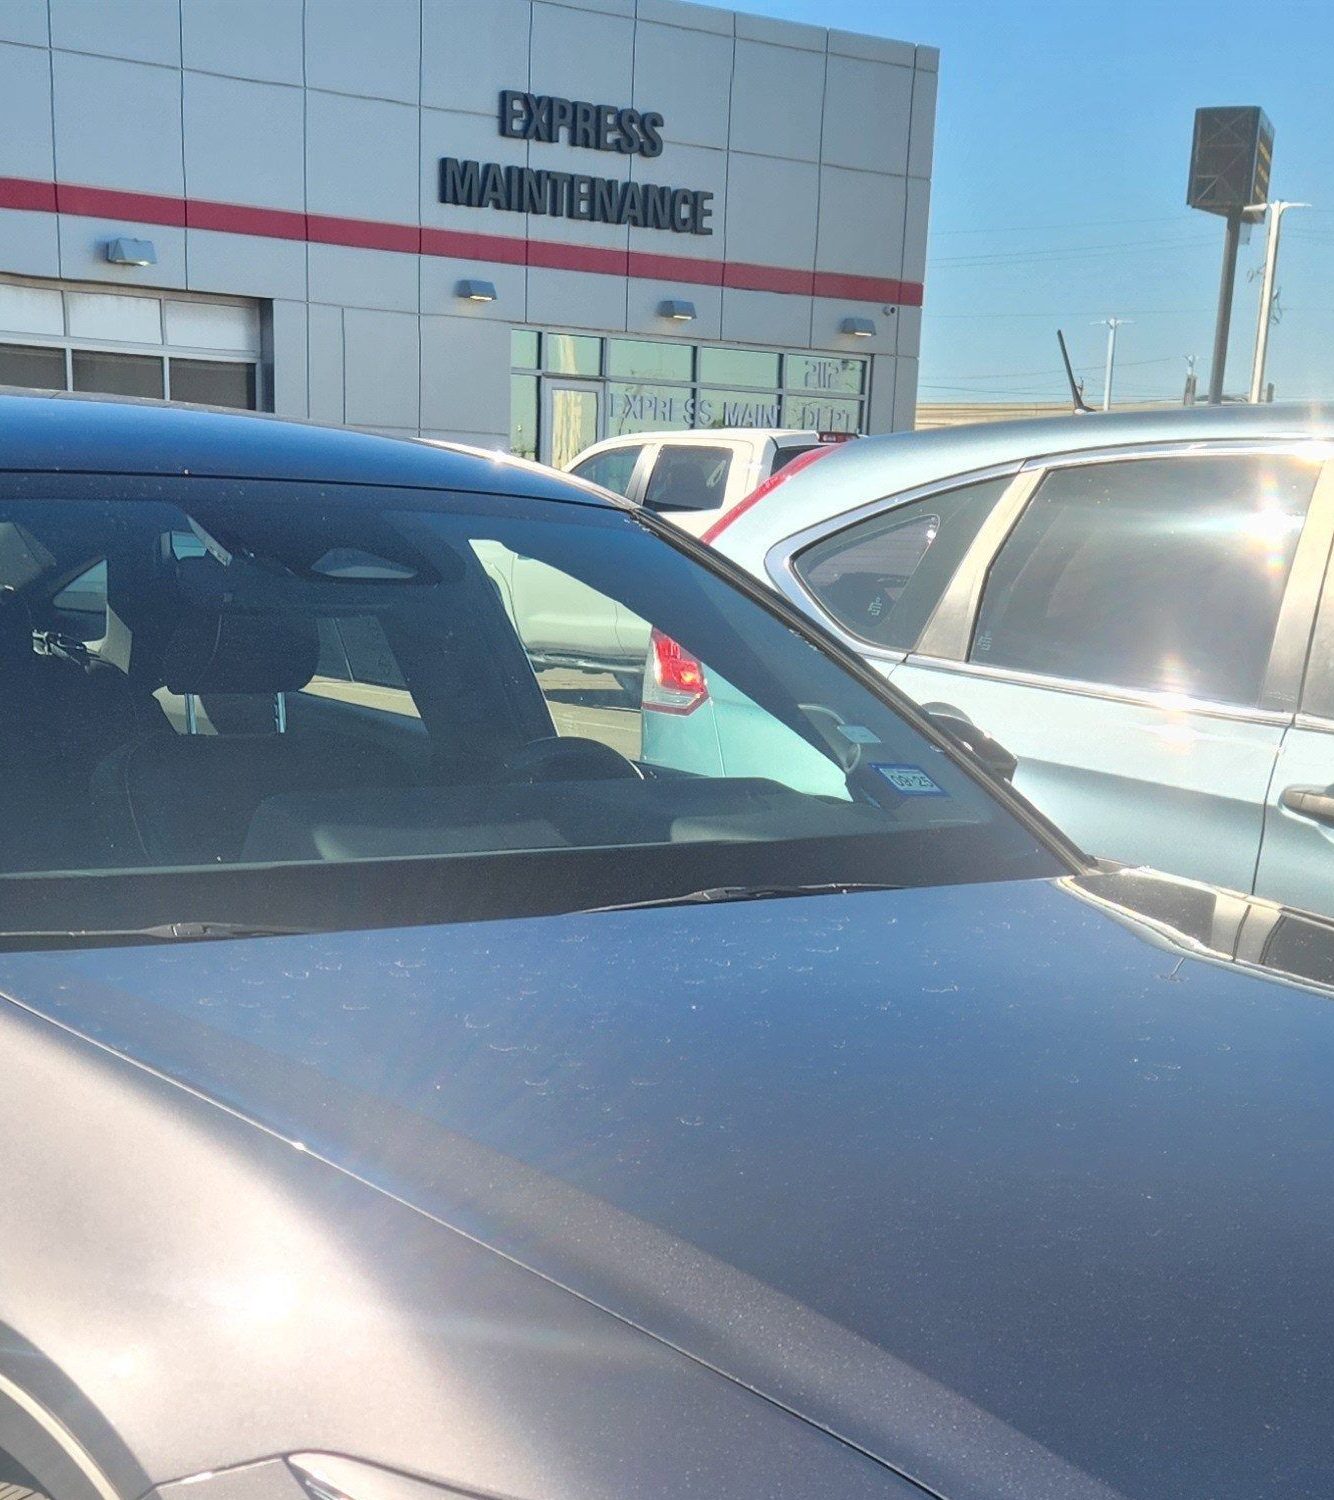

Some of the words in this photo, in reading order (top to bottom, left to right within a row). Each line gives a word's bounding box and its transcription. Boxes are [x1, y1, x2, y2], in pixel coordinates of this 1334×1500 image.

[498, 90, 664, 157] EXPRESS
[439, 157, 713, 235] MAINTENANCE
[609, 393, 715, 426] EXPRESS
